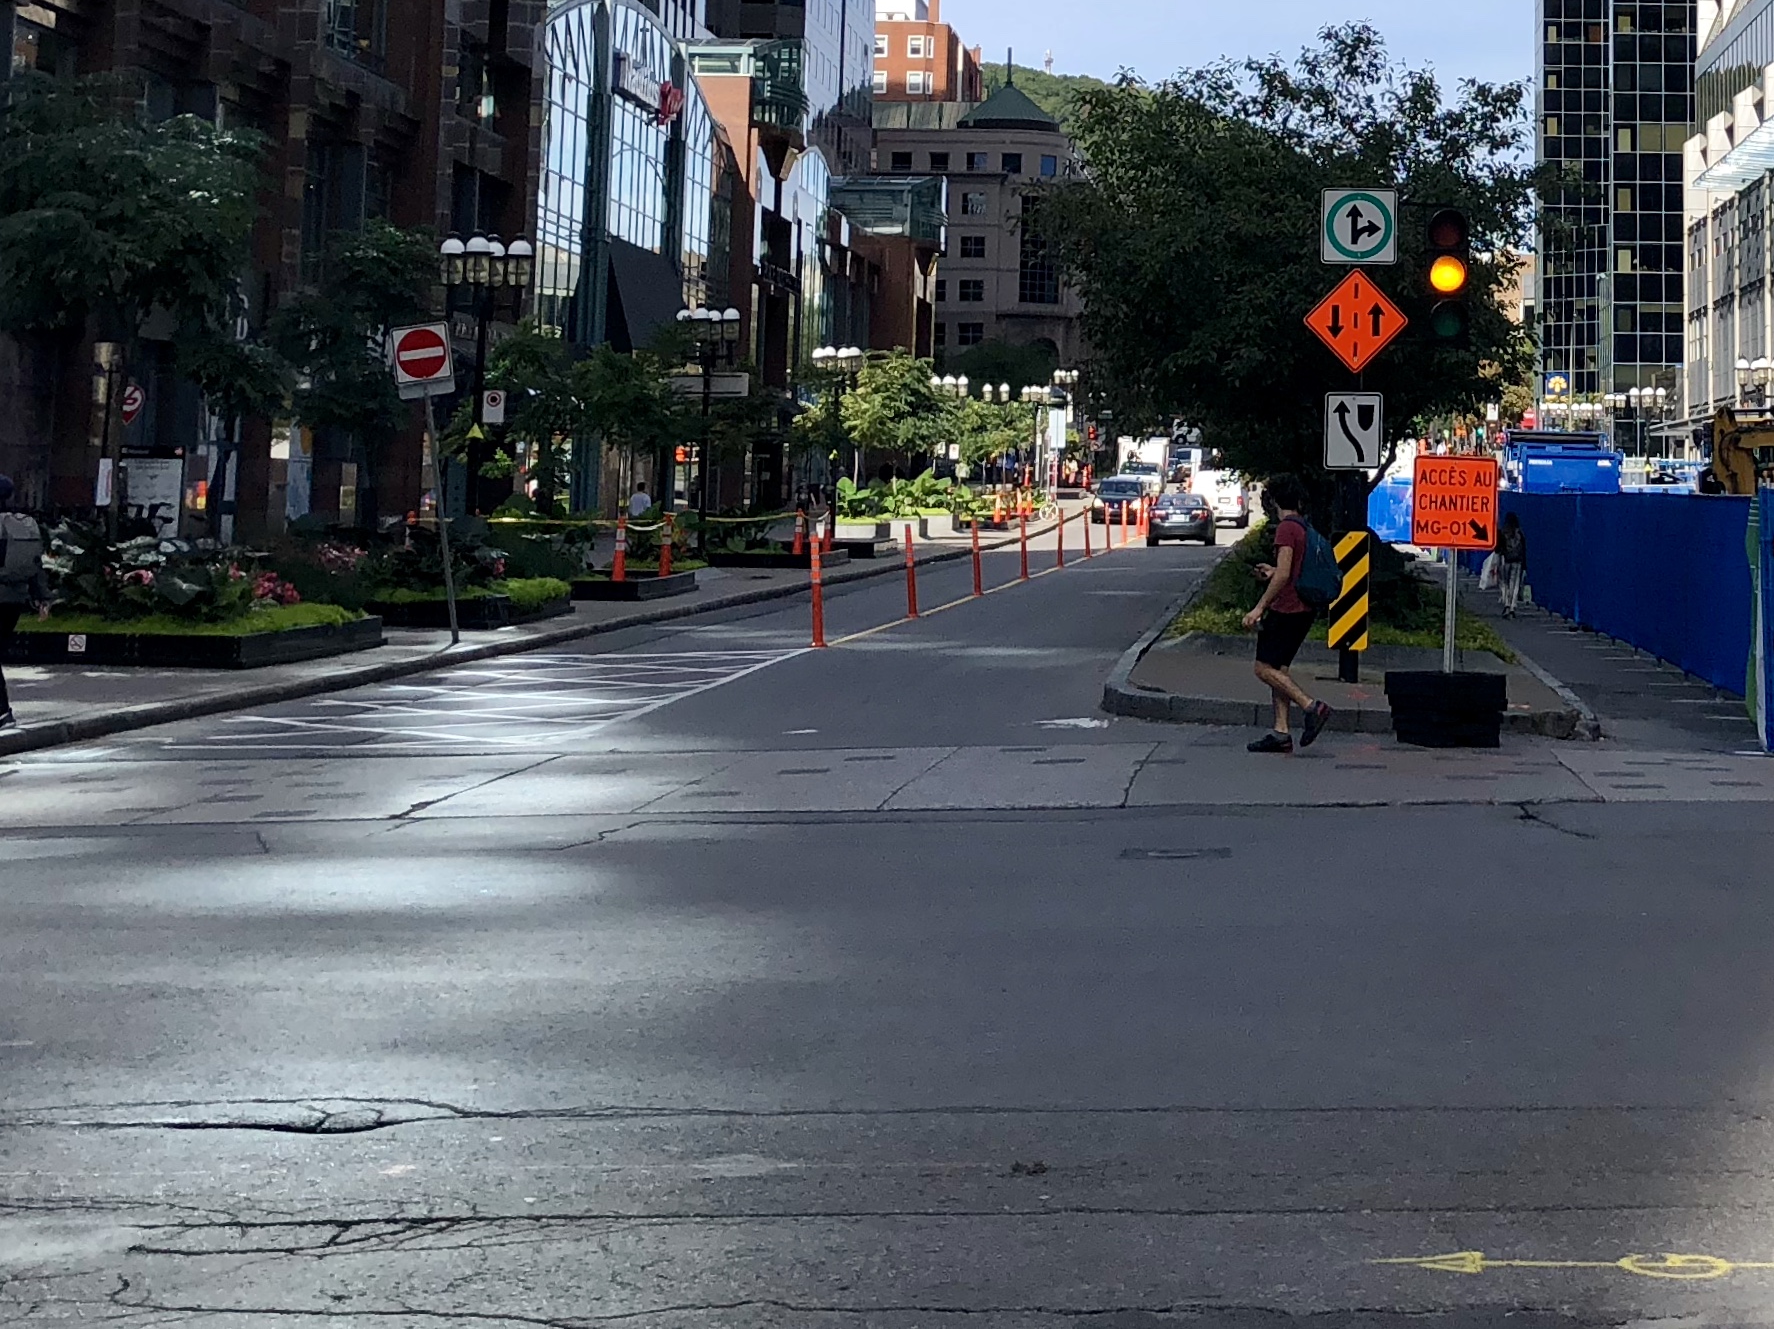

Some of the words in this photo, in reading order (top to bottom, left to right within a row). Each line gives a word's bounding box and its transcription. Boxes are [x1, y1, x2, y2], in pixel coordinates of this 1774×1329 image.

[1419, 466, 1467, 486] ACCÈS
[1473, 471, 1492, 487] AU
[1419, 493, 1490, 512] CHANTIER
